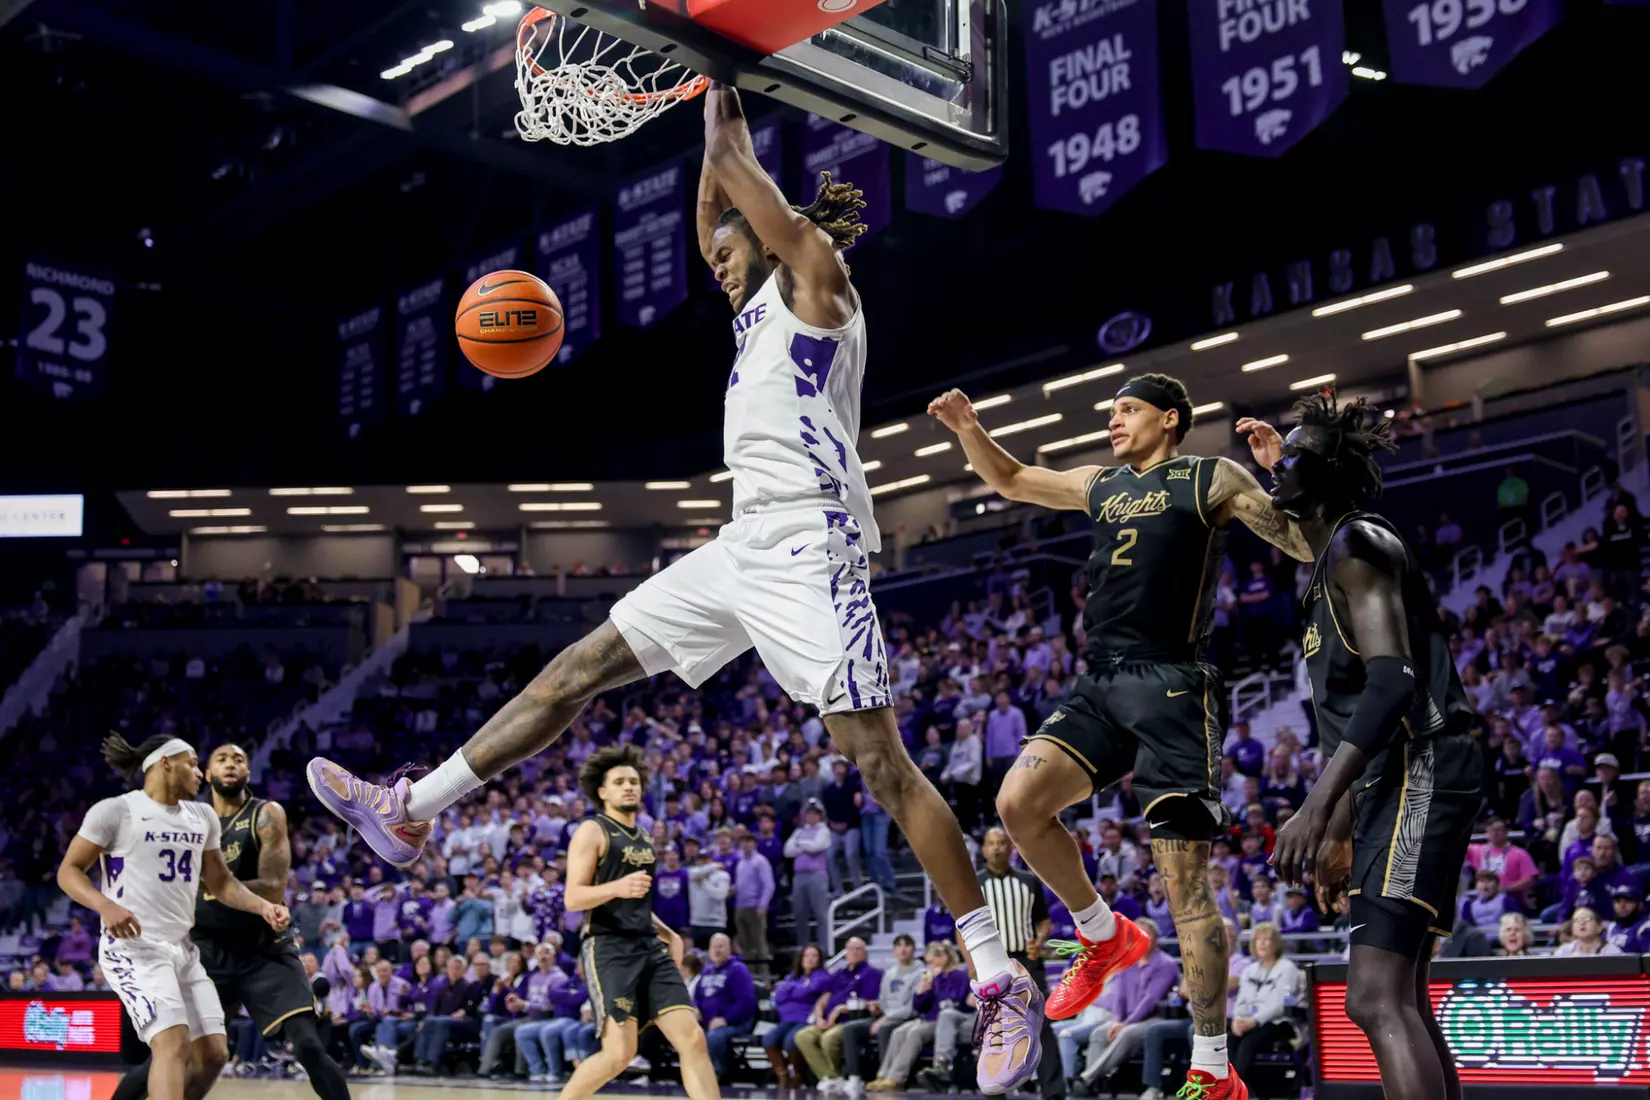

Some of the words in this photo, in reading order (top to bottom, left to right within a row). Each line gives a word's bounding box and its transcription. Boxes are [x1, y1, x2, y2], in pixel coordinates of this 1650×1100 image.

[1219, 0, 1311, 52] FOUR
[1049, 32, 1133, 87] FINAL
[1222, 44, 1323, 116] 1951
[1050, 62, 1132, 117] FOUR
[1047, 113, 1141, 179] 1948
[26, 262, 115, 296] RICHMOND
[1212, 222, 1438, 327] KANSAS
[26, 287, 107, 362] 23
[479, 310, 537, 328] ELITE
[1096, 490, 1172, 523] Knights
[1111, 528, 1138, 566] 2
[144, 831, 204, 844] K-STATE
[158, 849, 192, 882] 34
